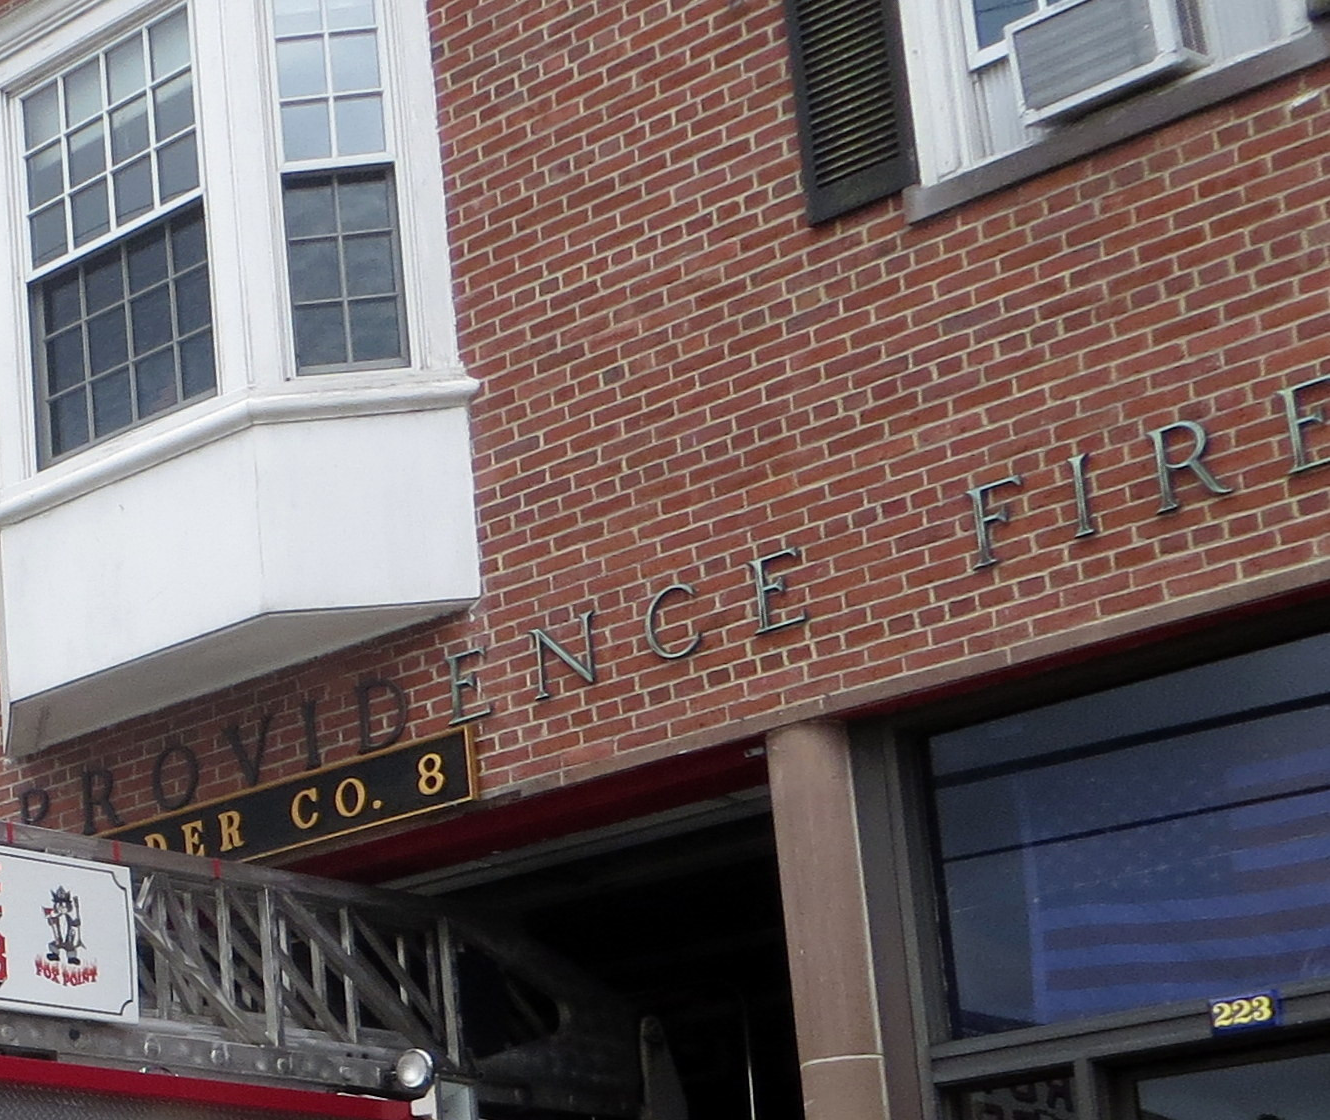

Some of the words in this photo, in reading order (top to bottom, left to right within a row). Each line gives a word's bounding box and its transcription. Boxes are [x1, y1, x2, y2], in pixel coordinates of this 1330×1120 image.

[19, 547, 806, 836] PROVIDENCE
[966, 373, 1330, 570] FIRE
[292, 777, 382, 830] CO.
[418, 752, 444, 796] 8
[62, 963, 99, 987] POINT
[1212, 995, 1274, 1028] 223
